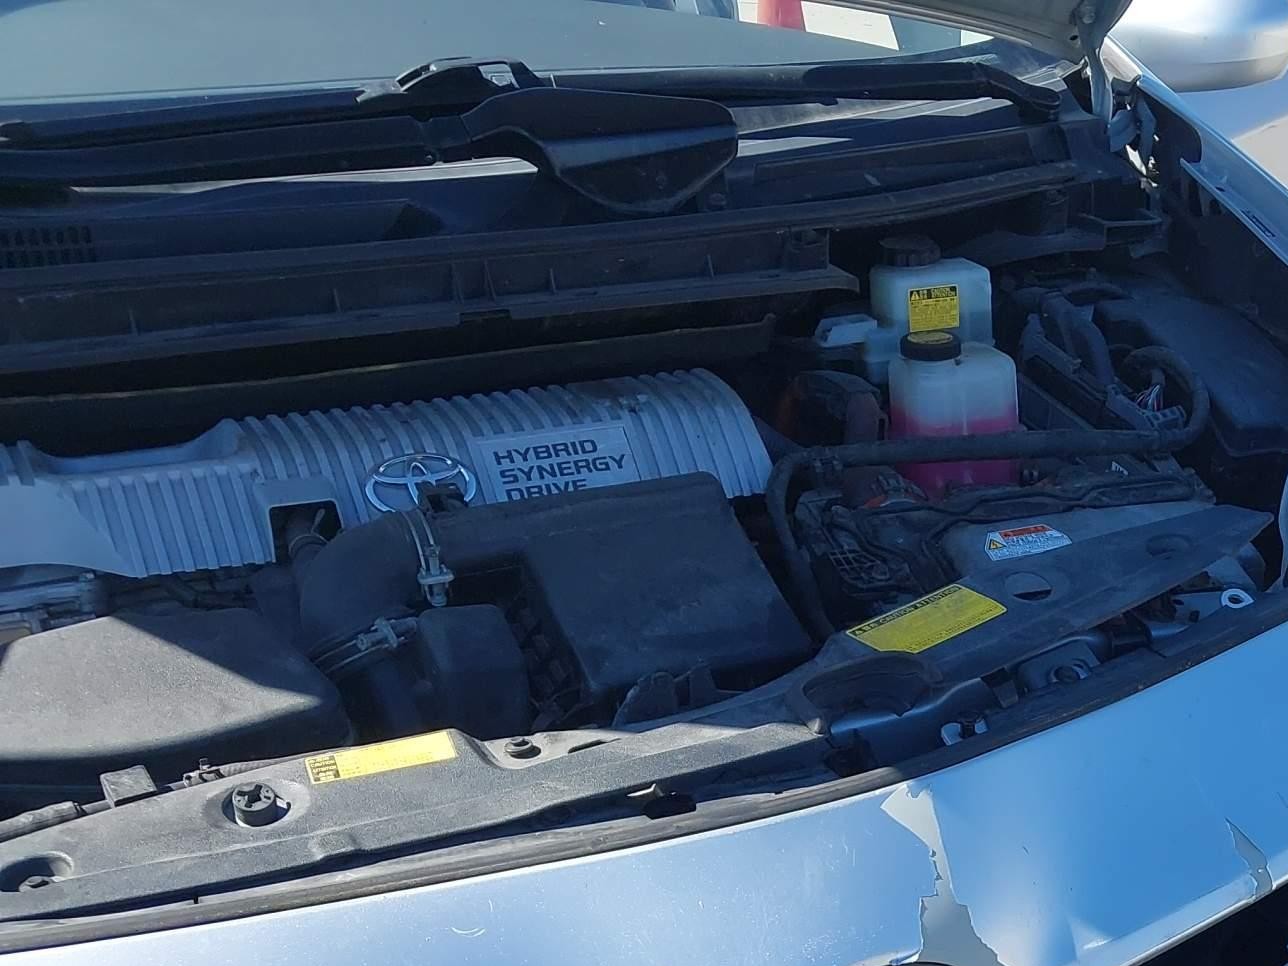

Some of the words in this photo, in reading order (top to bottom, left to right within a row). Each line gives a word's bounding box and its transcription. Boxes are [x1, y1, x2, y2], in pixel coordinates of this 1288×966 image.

[493, 439, 598, 466] HYBRID
[499, 454, 625, 485] SYNERGY
[505, 478, 588, 502] DRIVE
